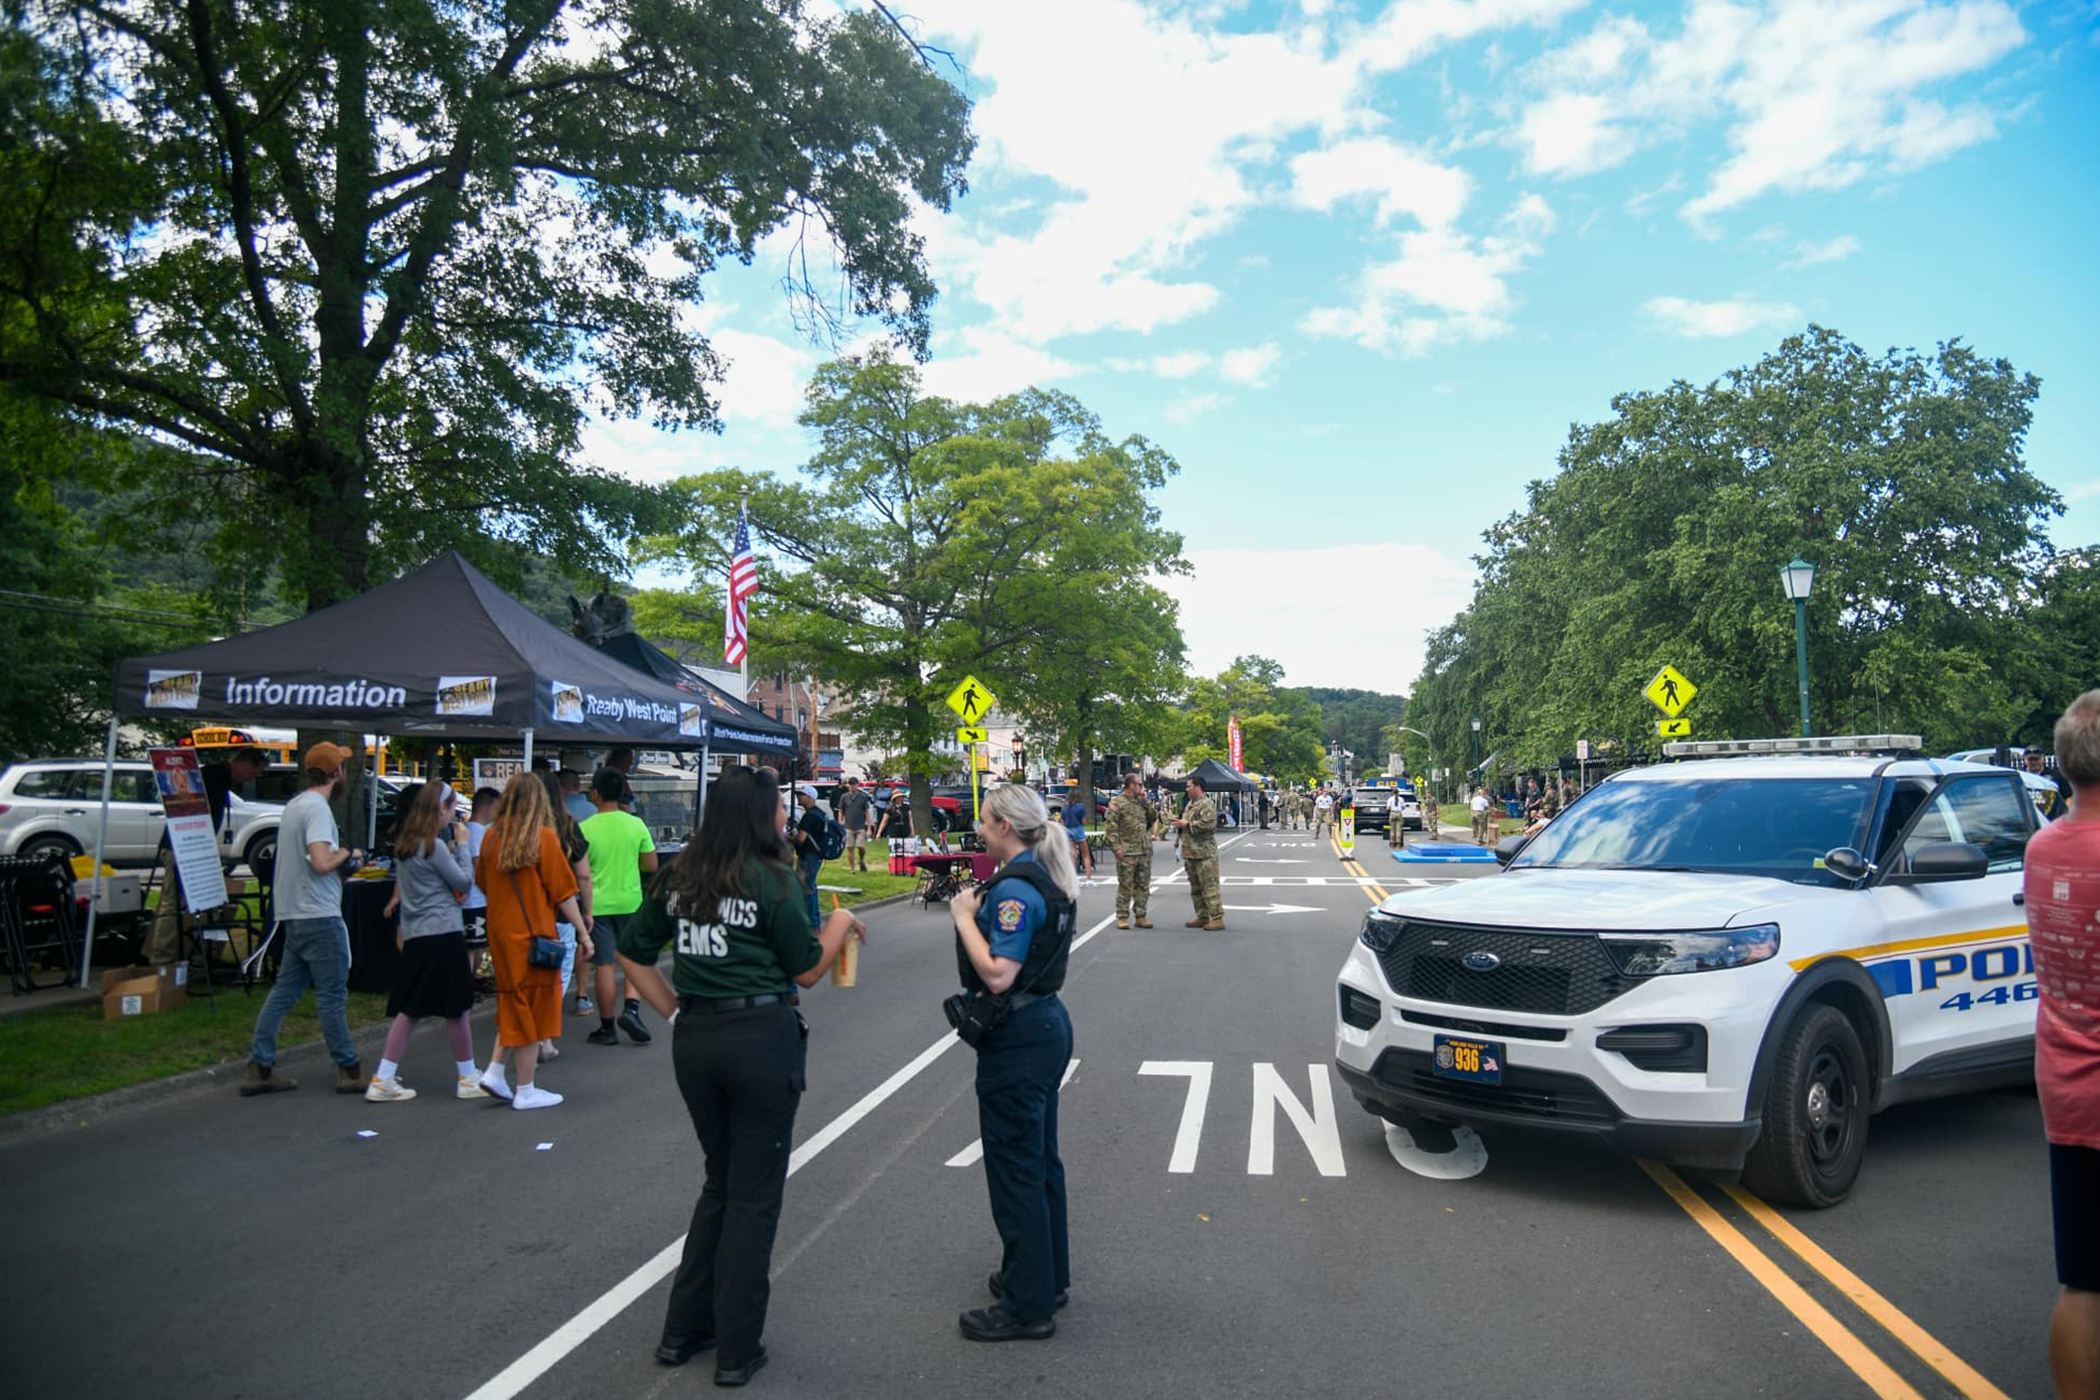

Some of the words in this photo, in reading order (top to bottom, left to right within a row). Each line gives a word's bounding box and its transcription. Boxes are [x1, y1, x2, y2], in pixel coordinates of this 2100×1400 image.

[227, 677, 407, 708] Information
[586, 694, 624, 722] Ready
[624, 698, 652, 720] West
[652, 703, 677, 724] Point
[496, 762, 525, 778] REA
[677, 919, 729, 957] EMS
[1917, 943, 2036, 992] PO
[1940, 981, 2038, 1012] 446
[1455, 1047, 1480, 1073] 936
